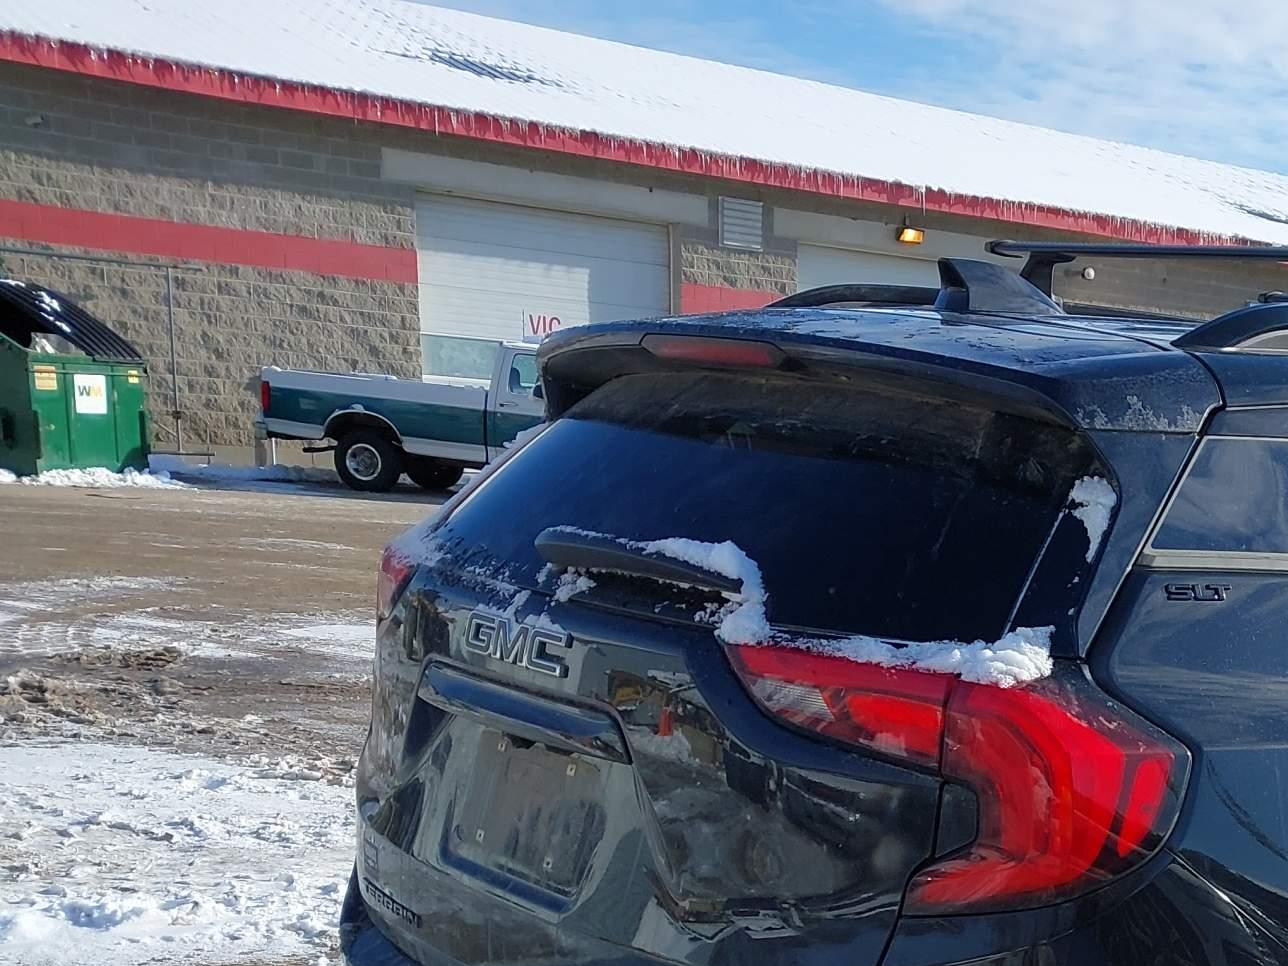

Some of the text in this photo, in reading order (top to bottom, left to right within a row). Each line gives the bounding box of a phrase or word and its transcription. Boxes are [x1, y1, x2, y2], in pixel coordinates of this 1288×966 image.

[78, 385, 103, 398] WM
[1164, 583, 1232, 602] SLT
[465, 610, 574, 678] GMC
